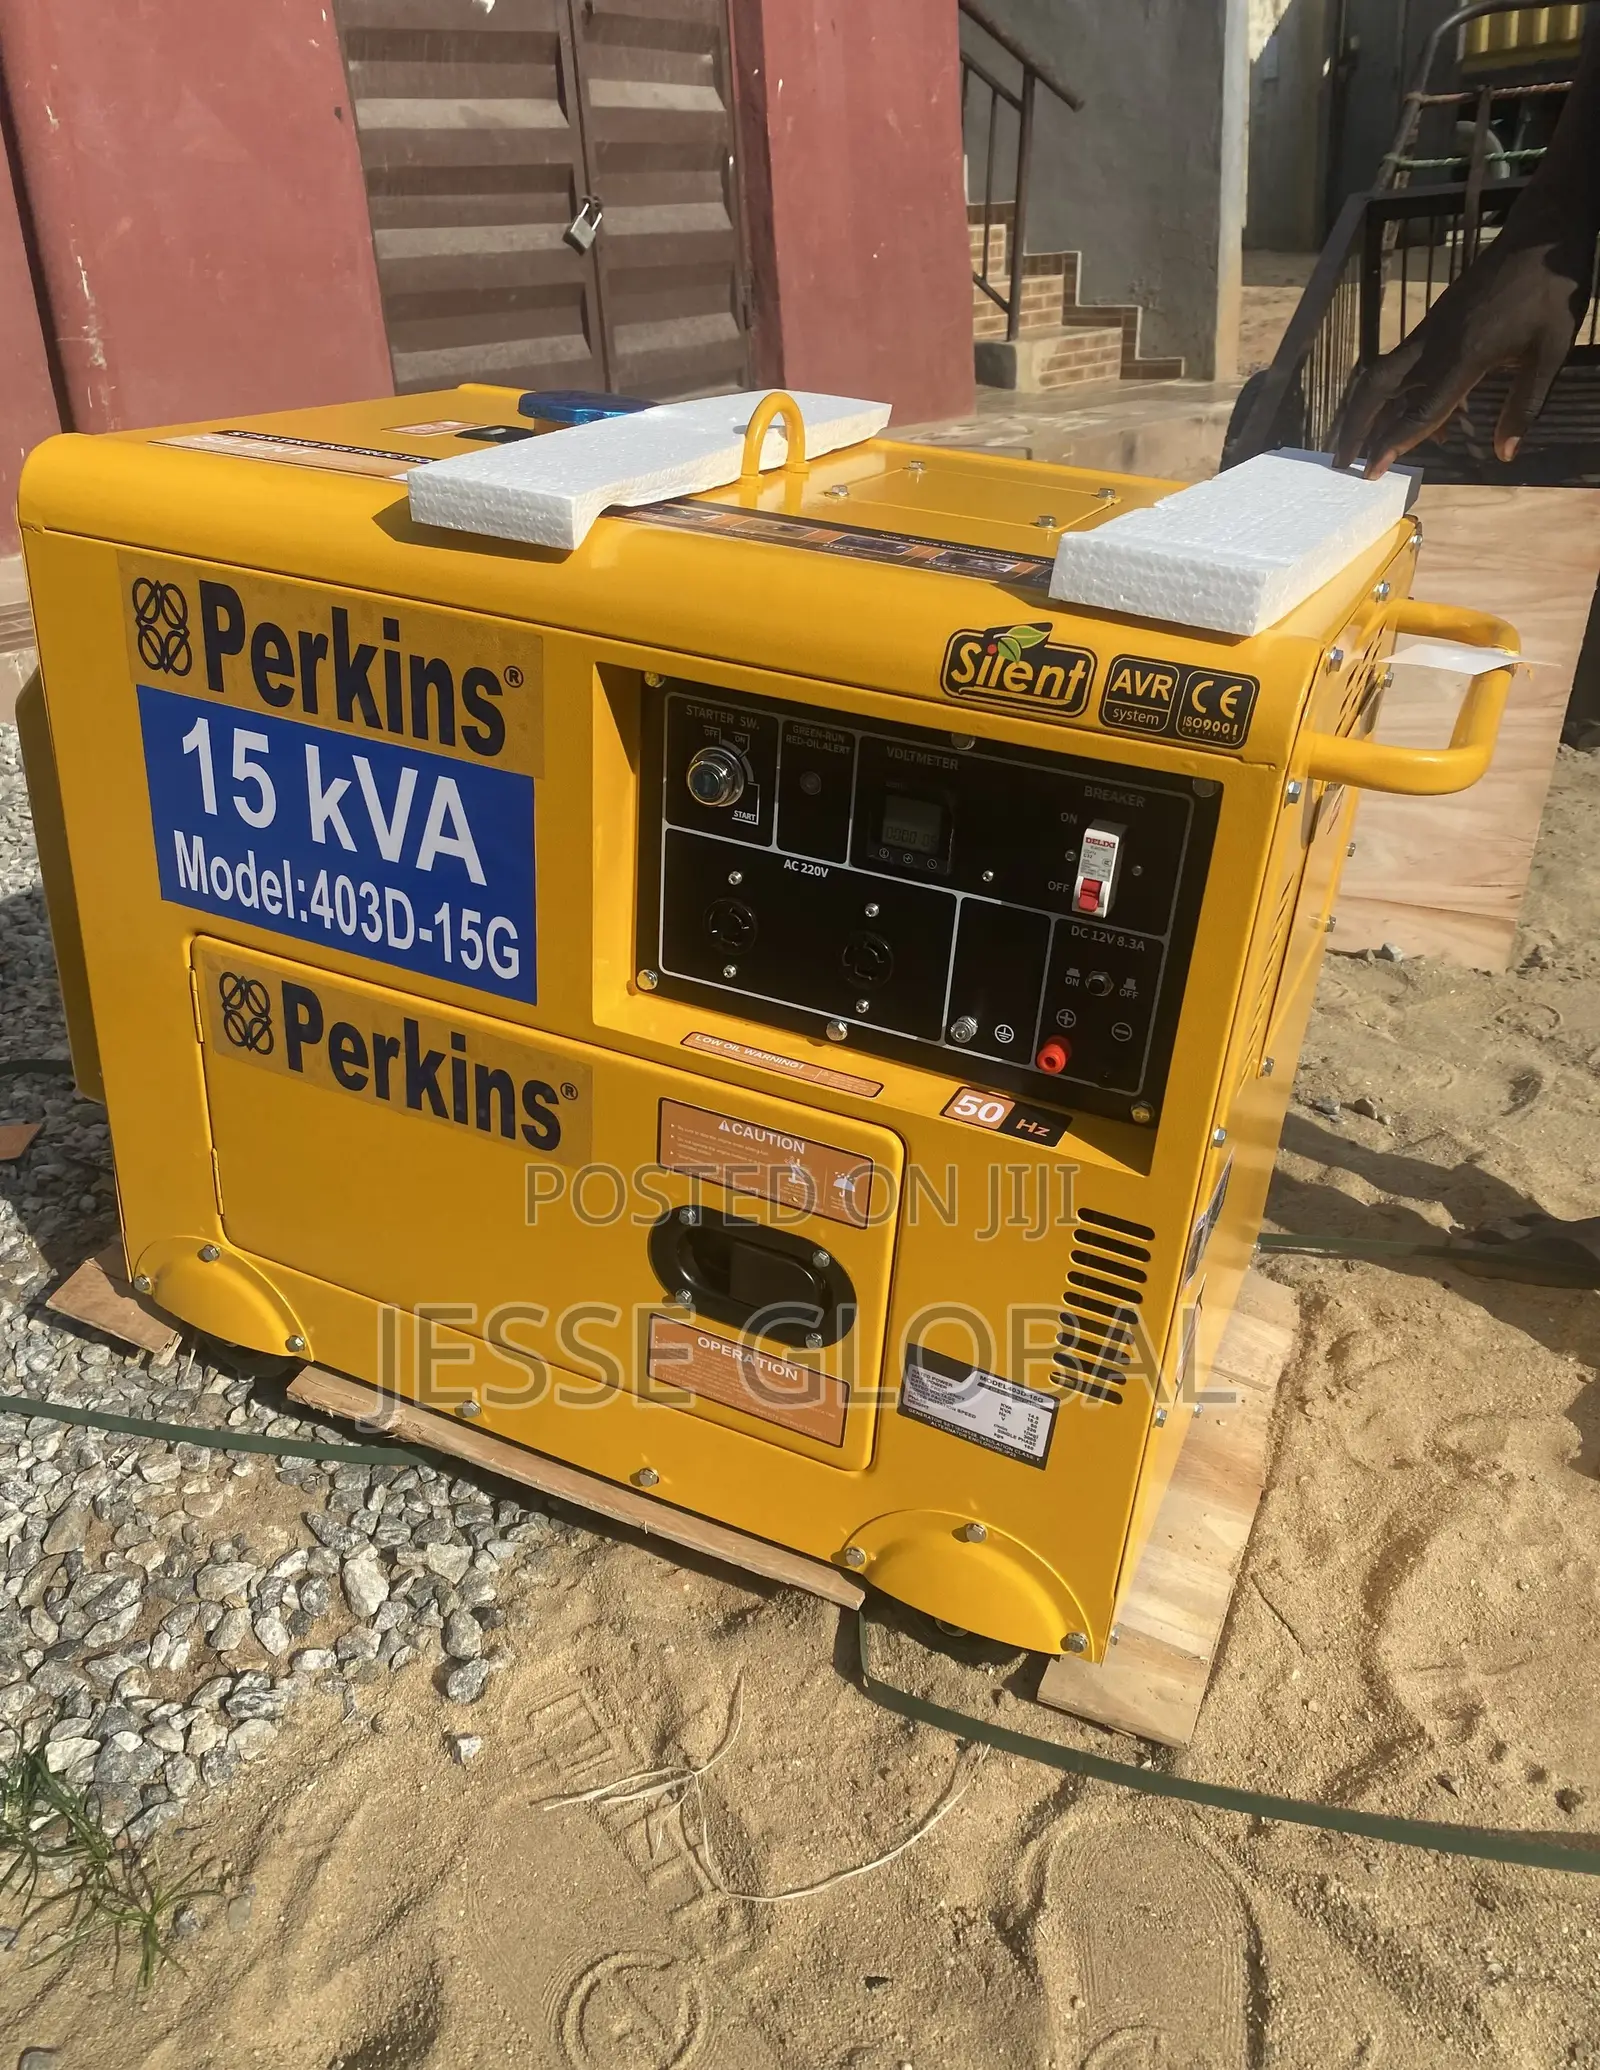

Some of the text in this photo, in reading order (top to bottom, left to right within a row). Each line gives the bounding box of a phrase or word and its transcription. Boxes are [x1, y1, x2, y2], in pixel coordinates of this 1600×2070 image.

[194, 434, 320, 456] SILENT
[228, 431, 436, 464] STARTING INSTRUCTIO
[951, 641, 1086, 702] Silent
[1111, 668, 1173, 701] AVR
[686, 705, 760, 730] STARTER SW.
[1112, 707, 1238, 736] system ISO9001
[704, 729, 746, 745] OFF ON
[793, 725, 844, 743] GREEN-RUN
[886, 745, 958, 771] VOLTMETER
[181, 716, 487, 887] 15 kVA
[1084, 785, 1146, 808] BREAKER
[733, 810, 756, 821] START
[1060, 812, 1078, 825] ON
[1085, 837, 1116, 849] DELIXI
[783, 859, 829, 878] AC 220V
[1047, 880, 1069, 893] OFF
[173, 830, 520, 980] Model:403D-15G
[1071, 925, 1145, 951] DC 12V 8.3A
[1065, 976, 1139, 1000] ON OFF
[694, 1034, 805, 1070] LOW OIL WARNING!
[953, 1094, 1051, 1137] 50 Hz
[732, 1123, 805, 1154] CAUTION
[697, 1336, 799, 1382] OPERATION
